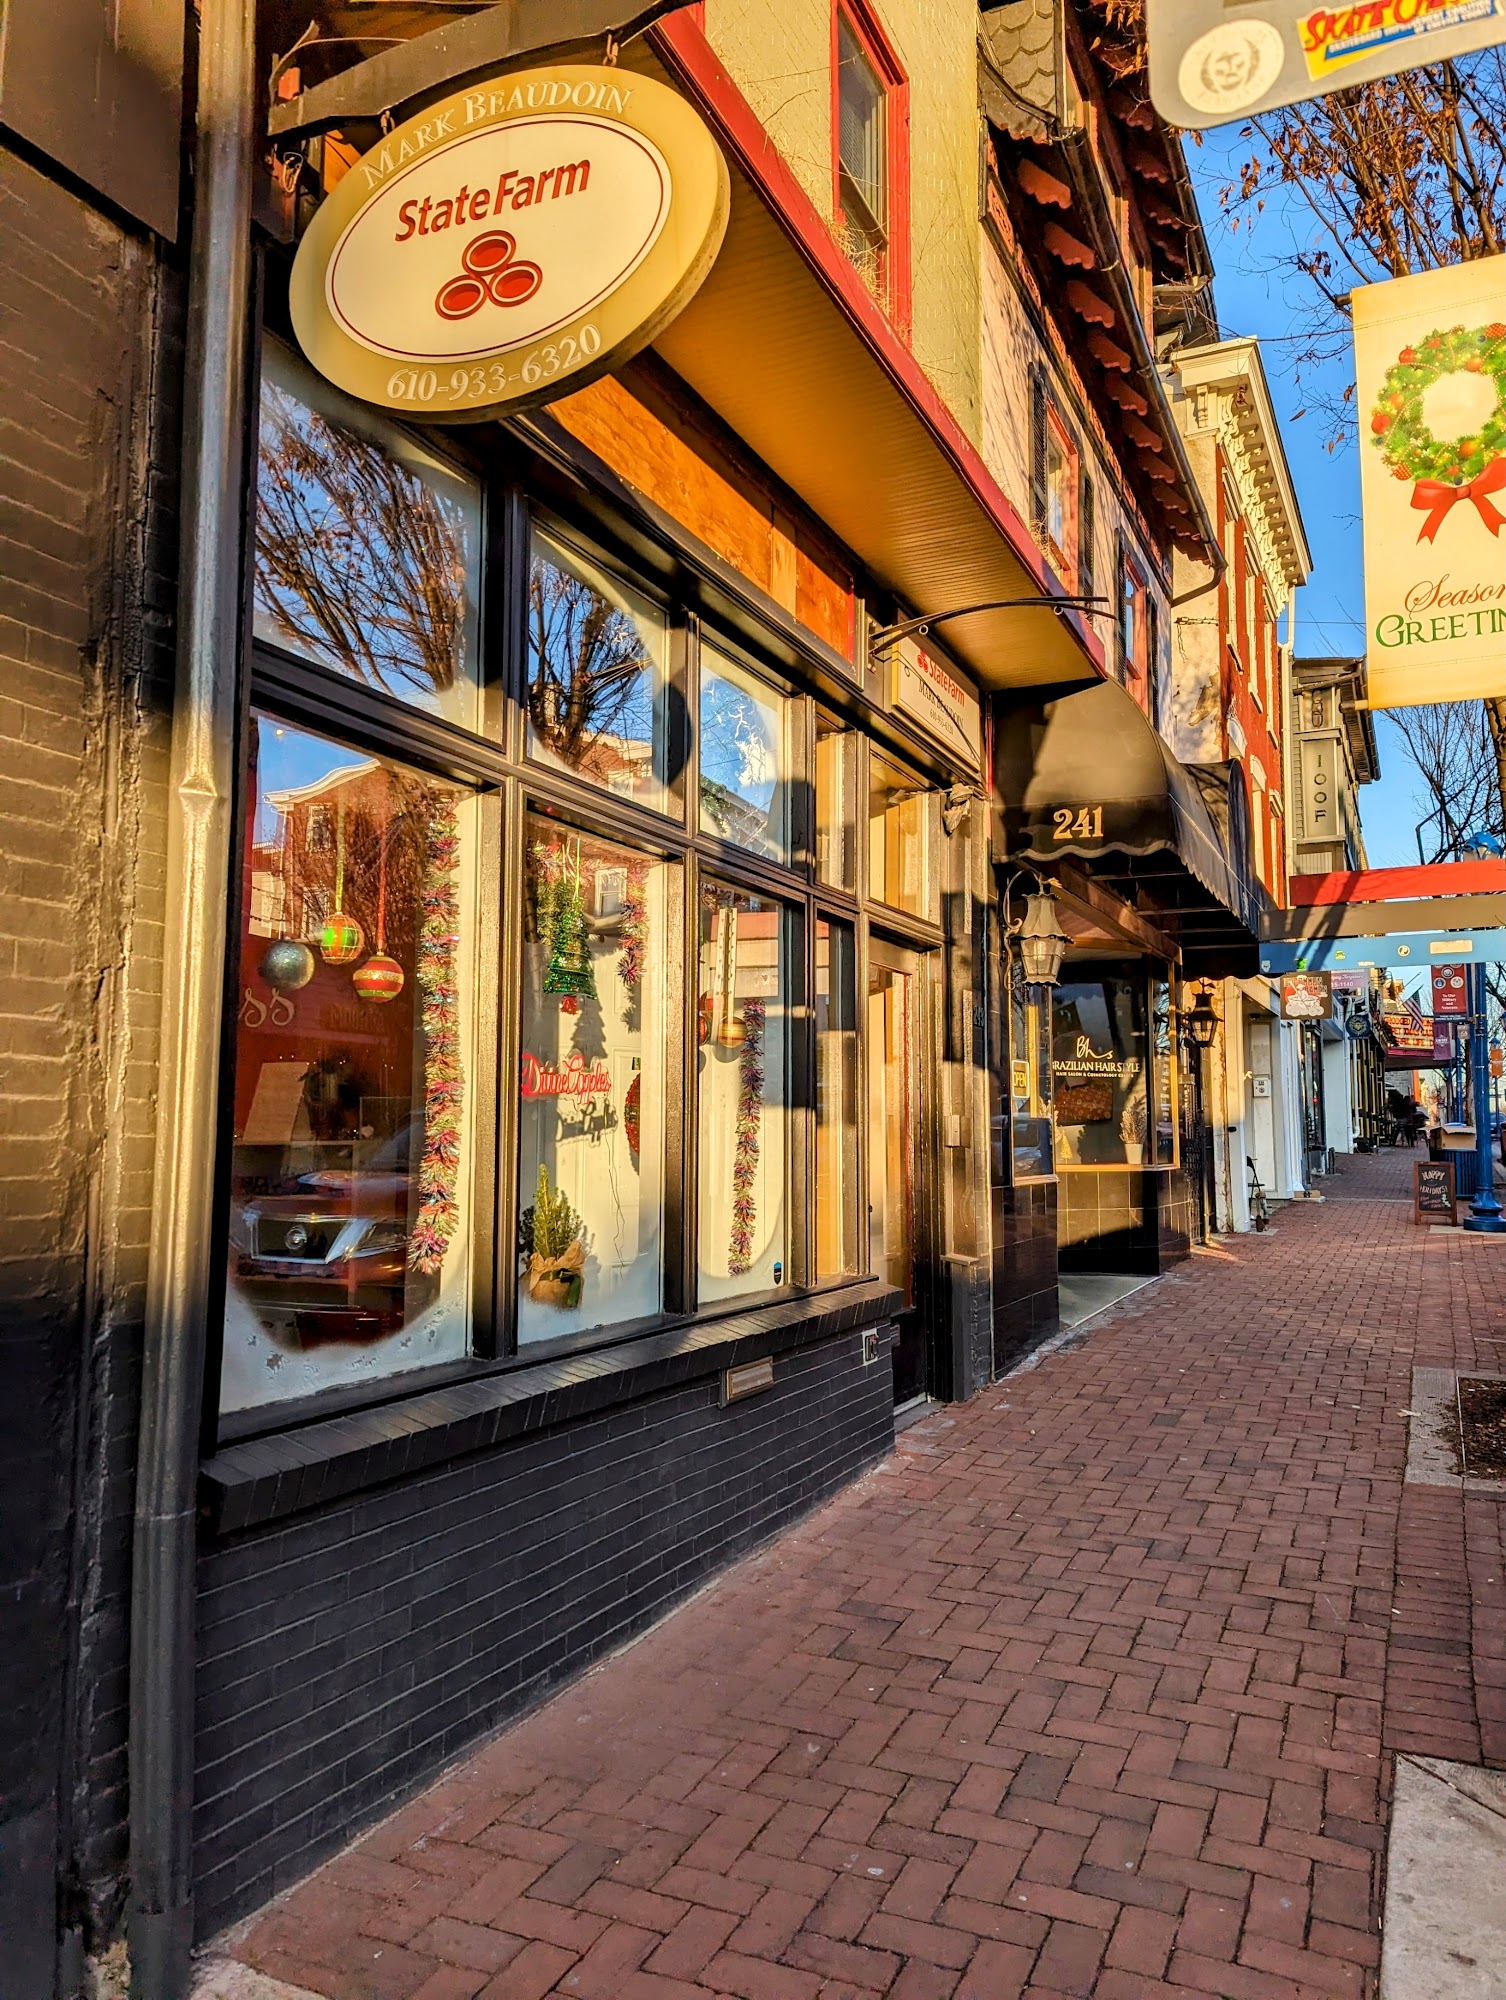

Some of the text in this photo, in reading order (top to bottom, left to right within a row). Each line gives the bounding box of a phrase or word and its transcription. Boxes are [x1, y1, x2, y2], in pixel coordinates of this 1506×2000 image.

[360, 80, 636, 190] MARK BEAUDOIN
[394, 159, 591, 242] StateFarm
[386, 323, 601, 401] 610-933-6320
[929, 660, 965, 707] StateFarm
[1053, 806, 1104, 840] 241
[1421, 1170, 1446, 1181] HAPPY
